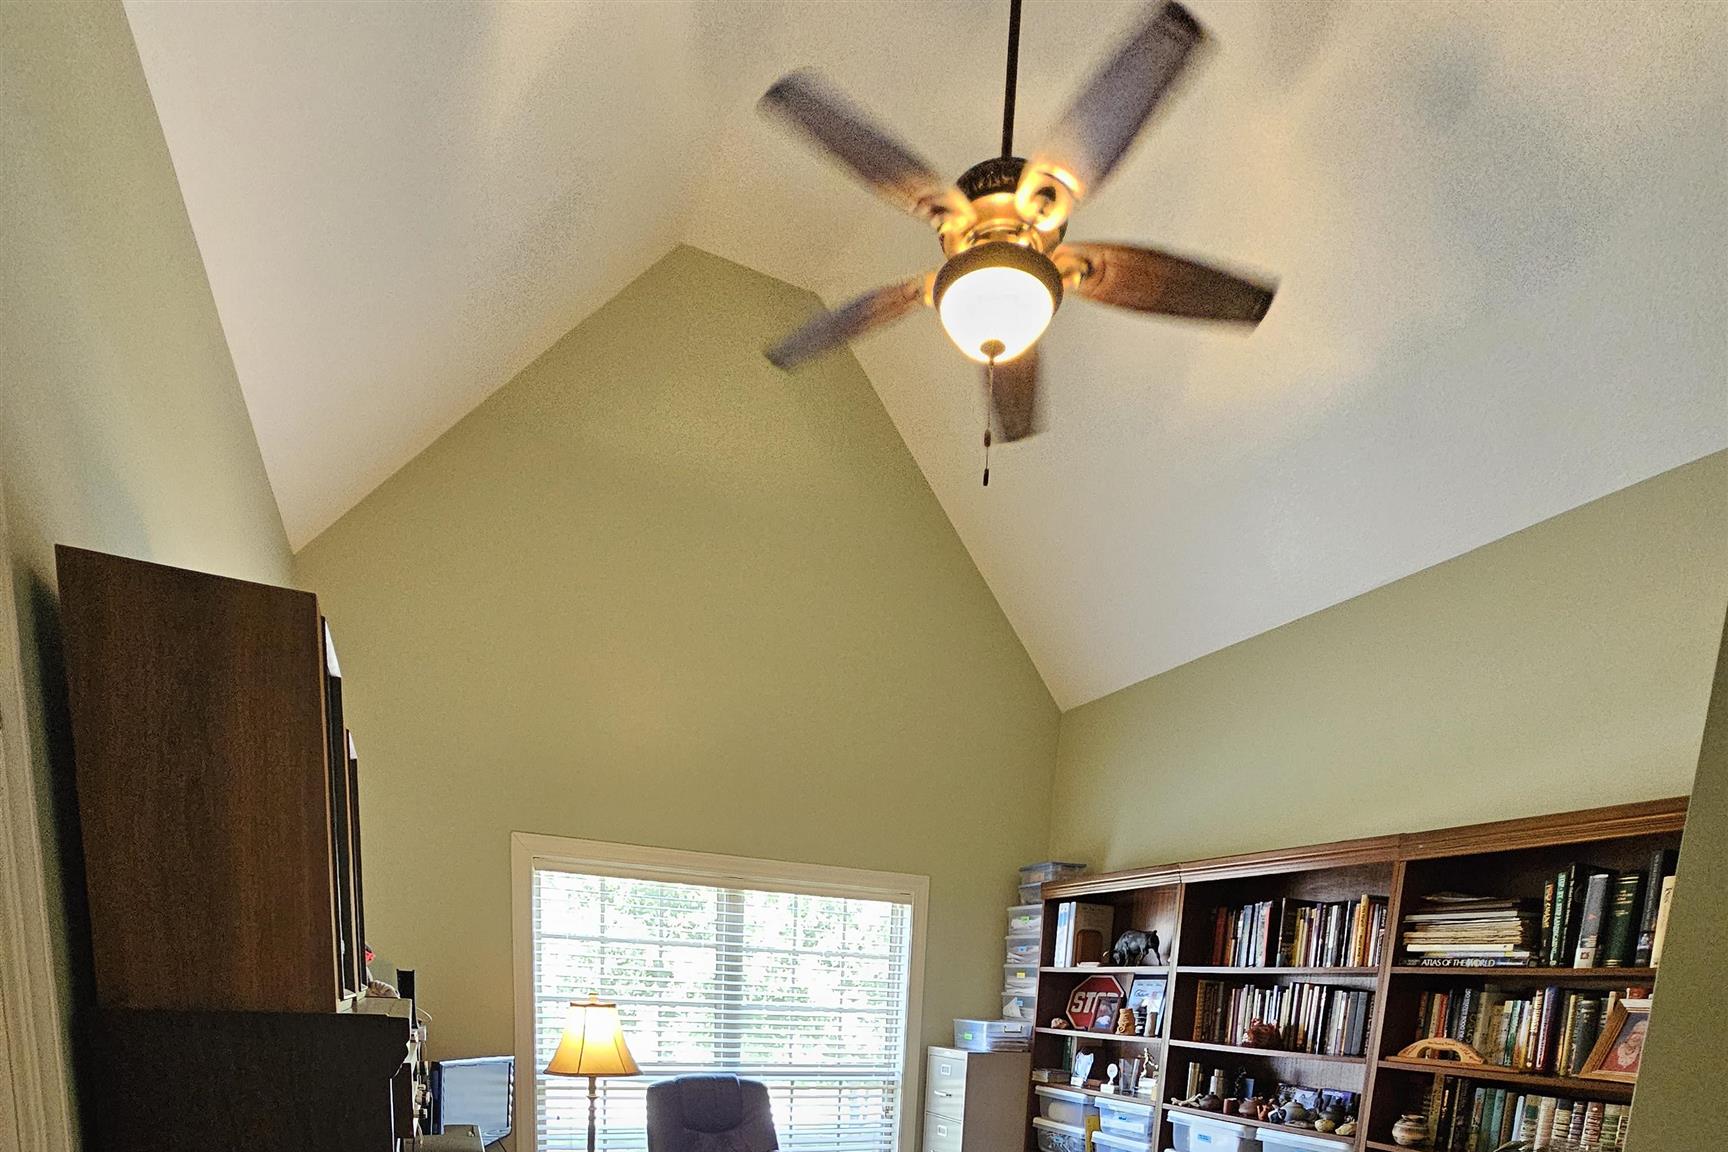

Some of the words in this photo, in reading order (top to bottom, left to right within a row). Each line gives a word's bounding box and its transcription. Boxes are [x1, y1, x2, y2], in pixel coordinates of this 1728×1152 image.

[1420, 959, 1441, 967] ATLAS
[1441, 959, 1452, 967] OF
[1452, 959, 1467, 967] THE
[1466, 958, 1495, 967] WORLD
